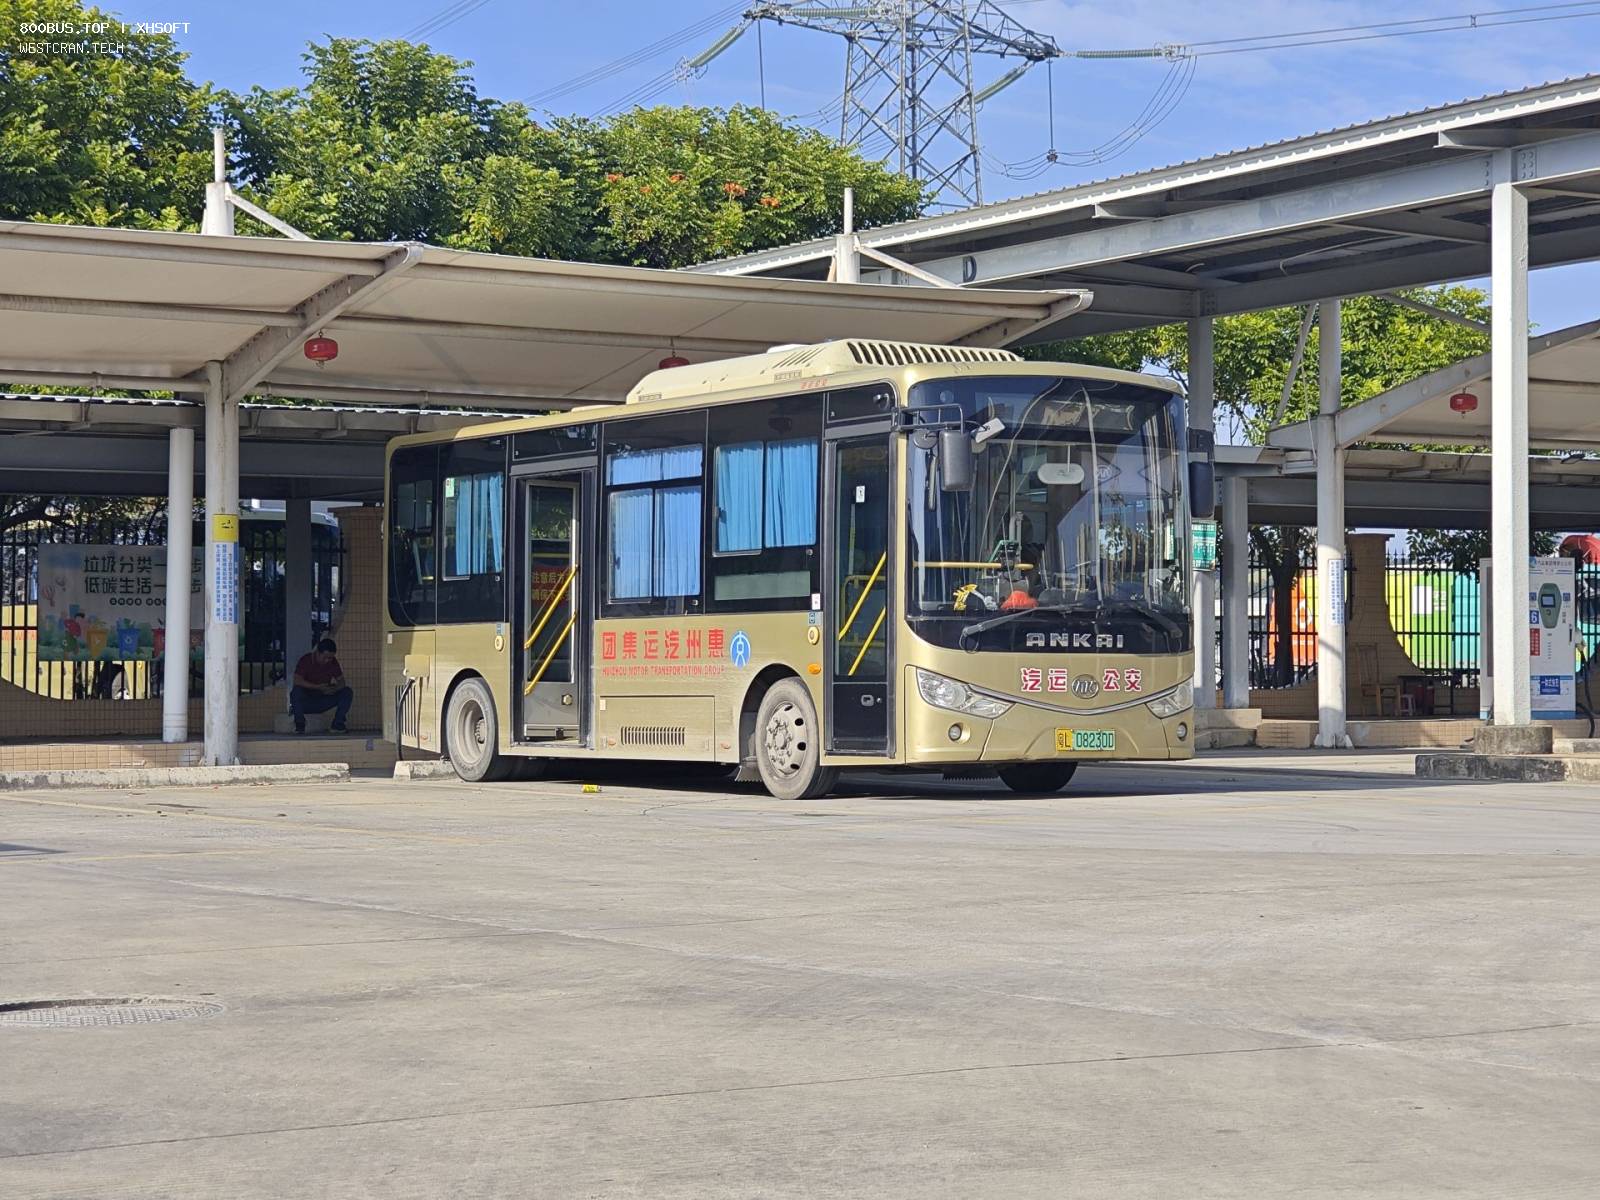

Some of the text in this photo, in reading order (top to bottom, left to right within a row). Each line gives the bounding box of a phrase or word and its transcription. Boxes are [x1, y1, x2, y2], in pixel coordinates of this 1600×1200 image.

[1026, 632, 1124, 648] ANKAI
[629, 666, 649, 675] MOTOR
[651, 666, 702, 675] TRANSPORTATION
[704, 665, 725, 675] GROUP
